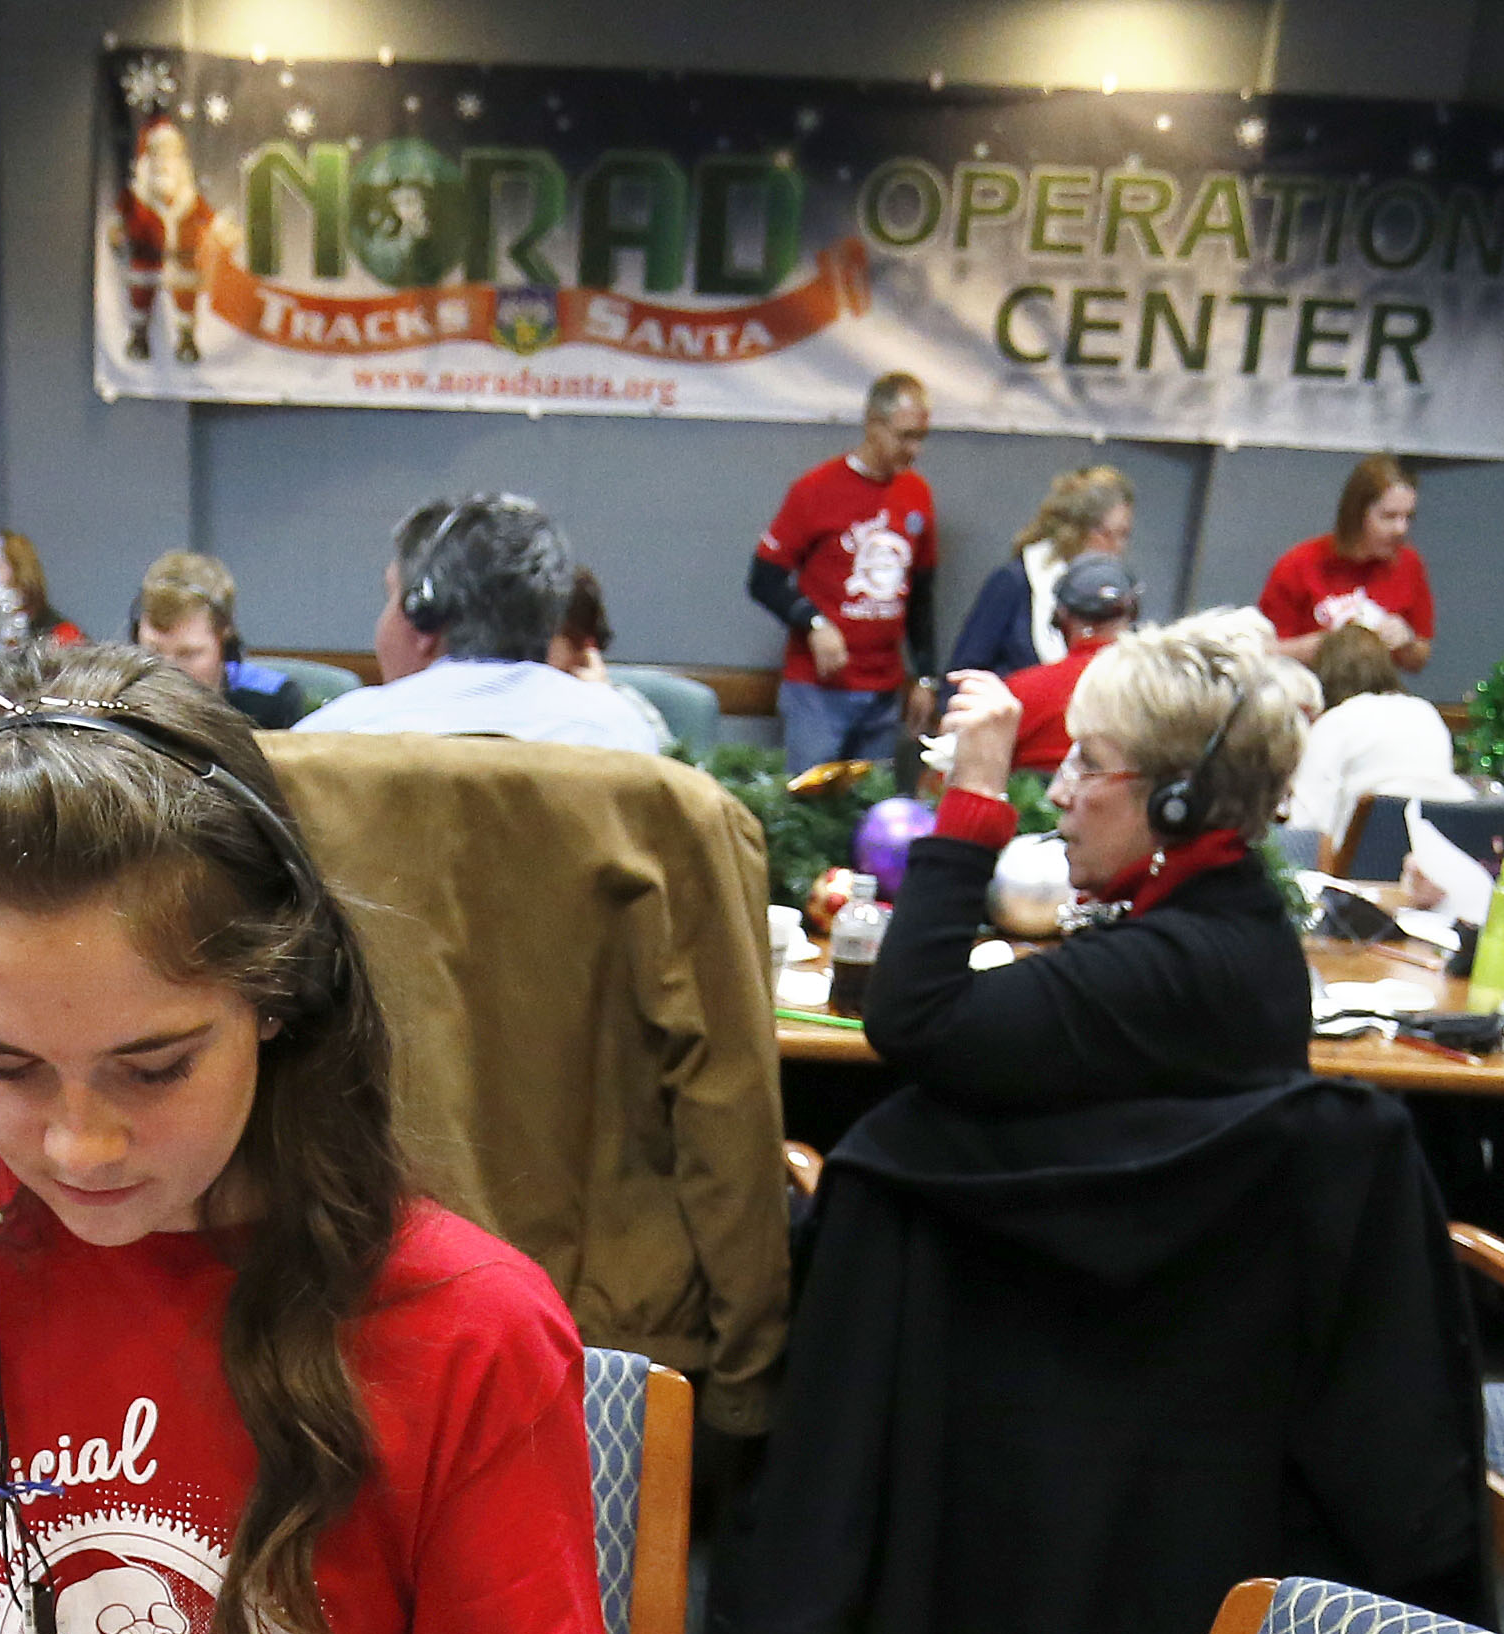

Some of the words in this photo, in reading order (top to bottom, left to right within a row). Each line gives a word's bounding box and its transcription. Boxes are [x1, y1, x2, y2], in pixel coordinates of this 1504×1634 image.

[240, 138, 805, 298] NORAD
[257, 292, 472, 344] TRACKS
[583, 293, 778, 354] SANTA
[996, 283, 1434, 385] CENTER
[352, 367, 678, 407] www.noradsanta.org
